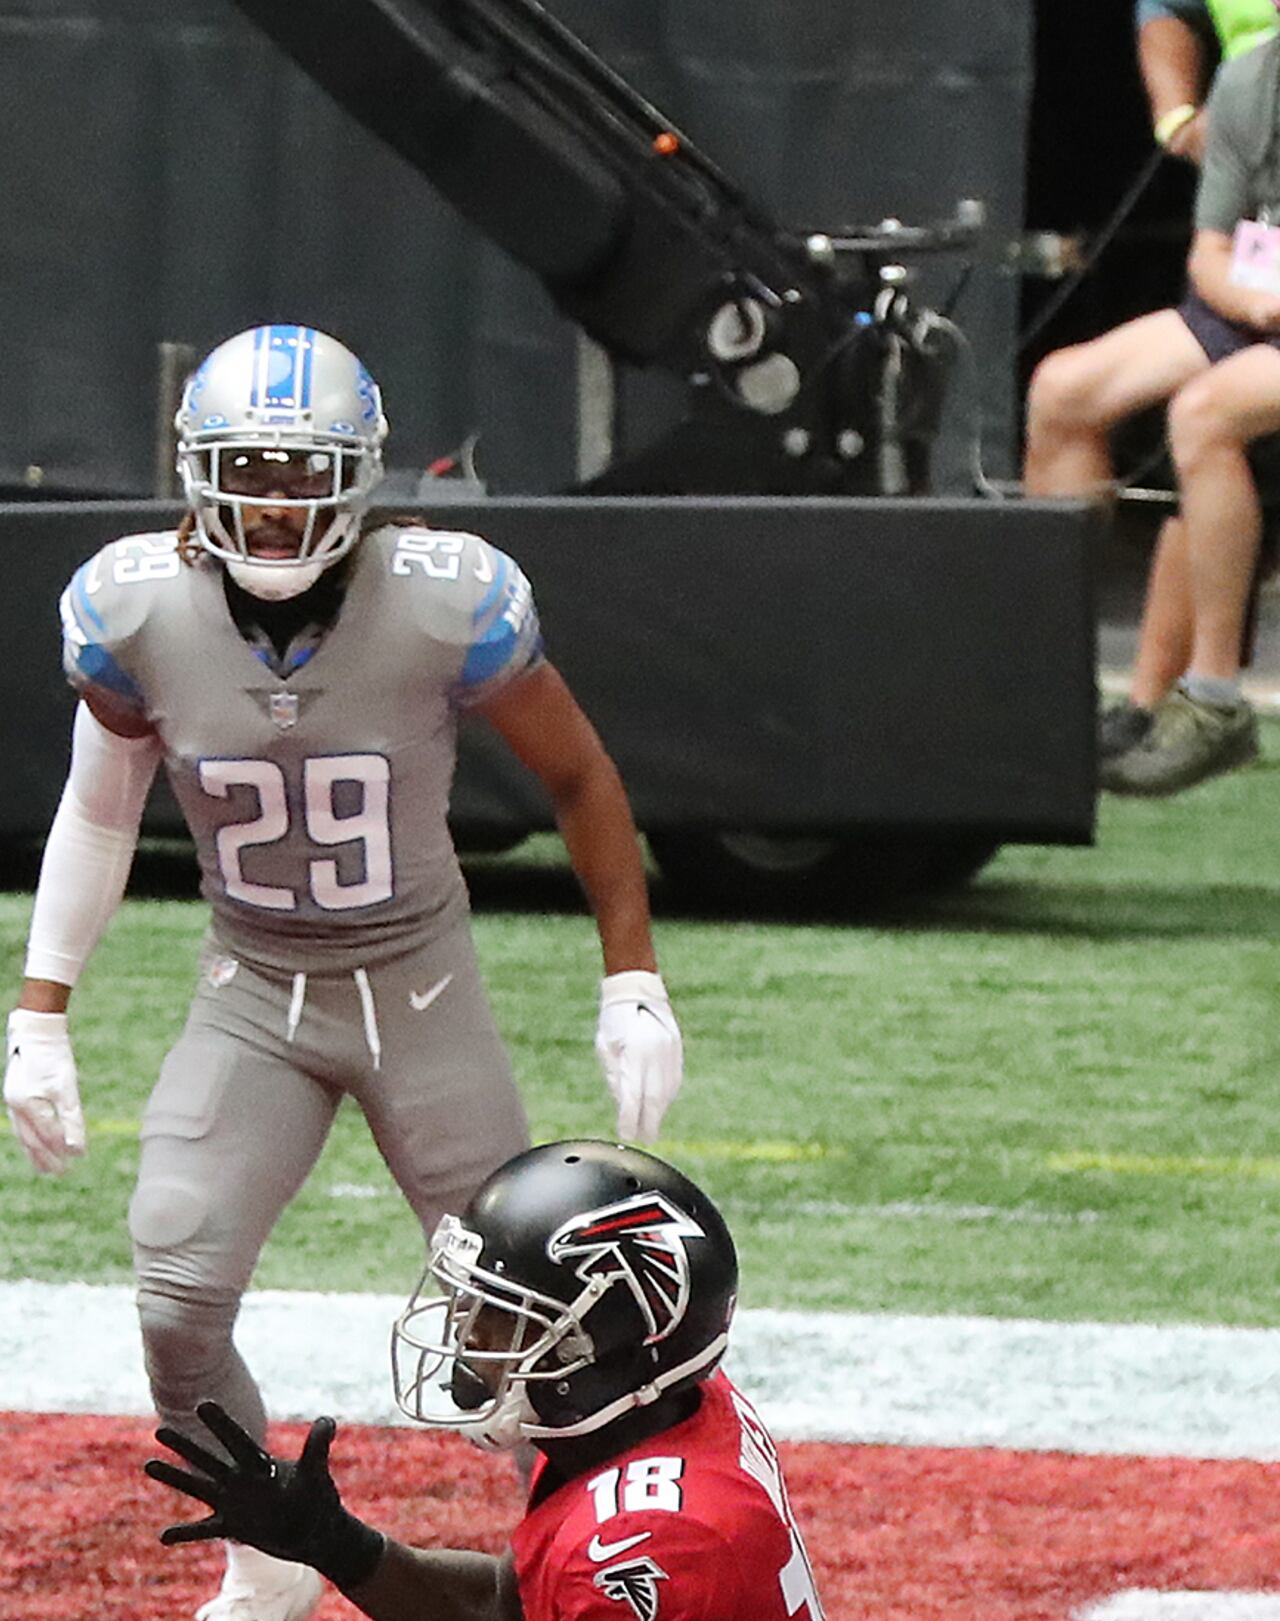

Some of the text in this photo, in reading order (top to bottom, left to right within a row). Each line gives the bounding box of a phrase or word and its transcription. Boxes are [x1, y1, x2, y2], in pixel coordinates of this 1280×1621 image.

[113, 533, 181, 585] 29
[392, 533, 466, 581] 29
[197, 751, 395, 912] 29
[586, 1456, 686, 1524] 18
